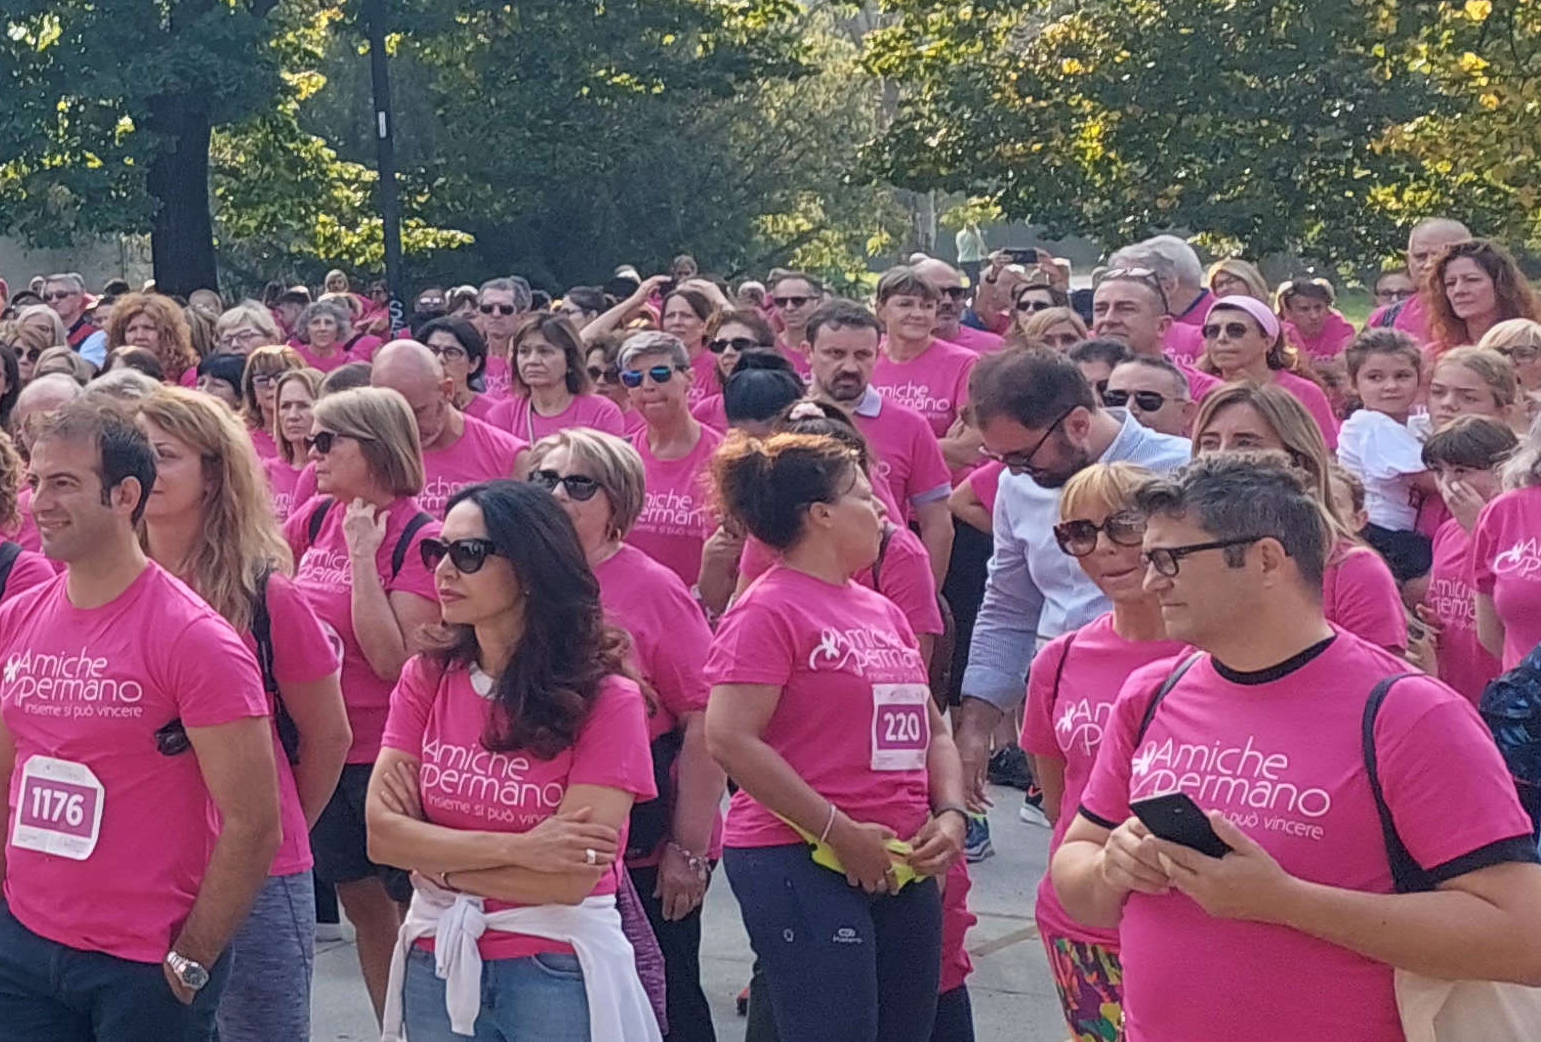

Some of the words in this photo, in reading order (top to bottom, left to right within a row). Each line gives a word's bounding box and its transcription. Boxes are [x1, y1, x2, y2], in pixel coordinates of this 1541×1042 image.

[877, 380, 929, 398] miche
[19, 646, 108, 678] Amiche
[18, 676, 143, 707] permano
[73, 703, 93, 720] può
[97, 705, 143, 718] vincere
[883, 712, 921, 742] 220
[1150, 735, 1289, 780] Amiche
[420, 763, 564, 809] permano
[1154, 769, 1331, 818] permano
[31, 786, 85, 827] 1176
[487, 804, 515, 823] può
[1263, 814, 1324, 841] vincere
